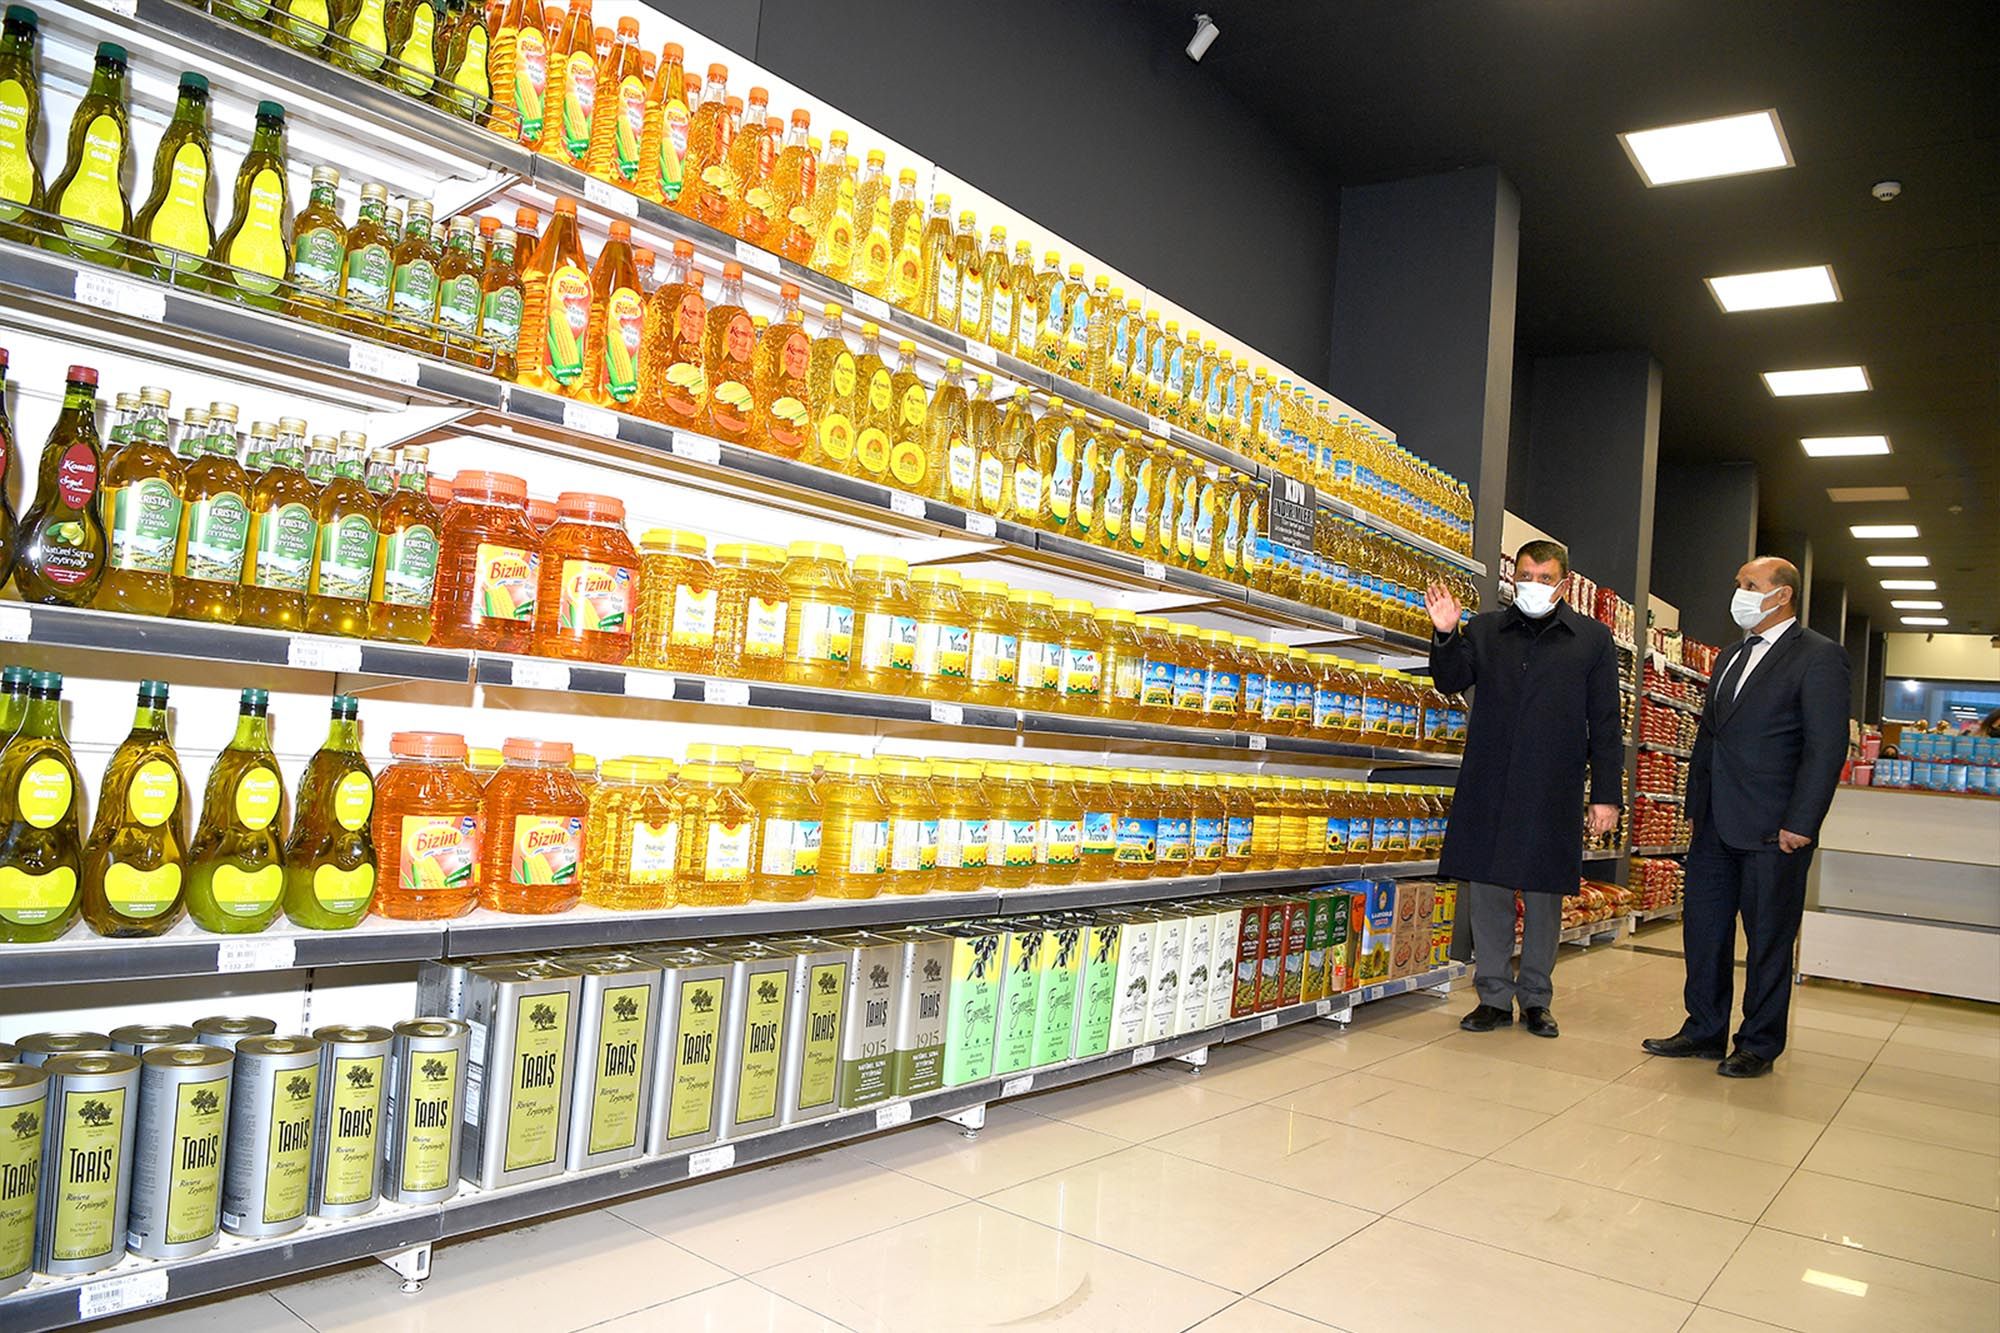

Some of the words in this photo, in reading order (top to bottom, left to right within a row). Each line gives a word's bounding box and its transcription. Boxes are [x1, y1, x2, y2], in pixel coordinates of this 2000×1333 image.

[0, 101, 26, 115] omili
[62, 459, 96, 474] Komili
[42, 545, 72, 556] Natürel
[47, 554, 88, 569] Zeytinyağı
[490, 561, 527, 579] Bizim
[574, 576, 612, 593] Bizim
[416, 831, 461, 851] Bizim
[528, 830, 566, 848] Bizim
[915, 1030, 940, 1049] 1915
[862, 1039, 887, 1059] 1915
